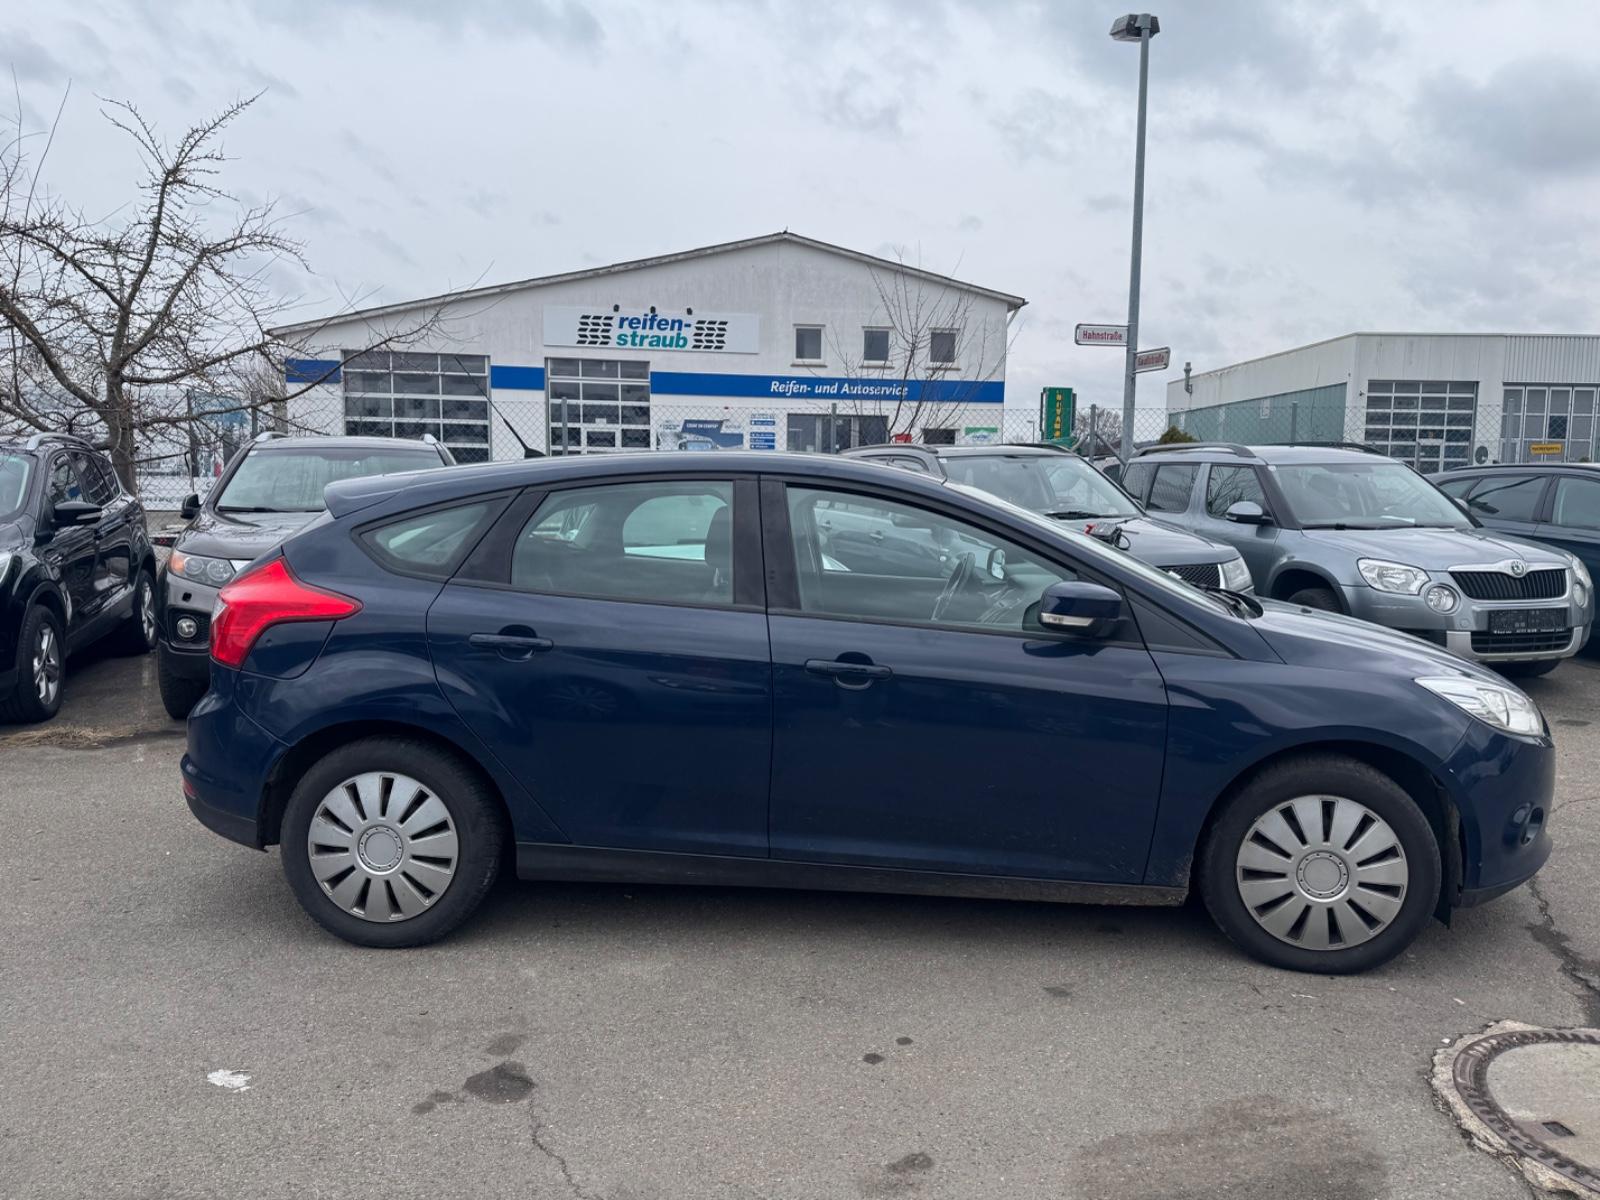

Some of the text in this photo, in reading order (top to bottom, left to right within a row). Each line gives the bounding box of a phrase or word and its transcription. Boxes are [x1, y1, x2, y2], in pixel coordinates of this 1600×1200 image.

[618, 313, 692, 331] reifen-
[616, 331, 688, 348] straub
[1082, 330, 1122, 341] Hahnstraße
[770, 380, 908, 396] Reifen- und Autoservice
